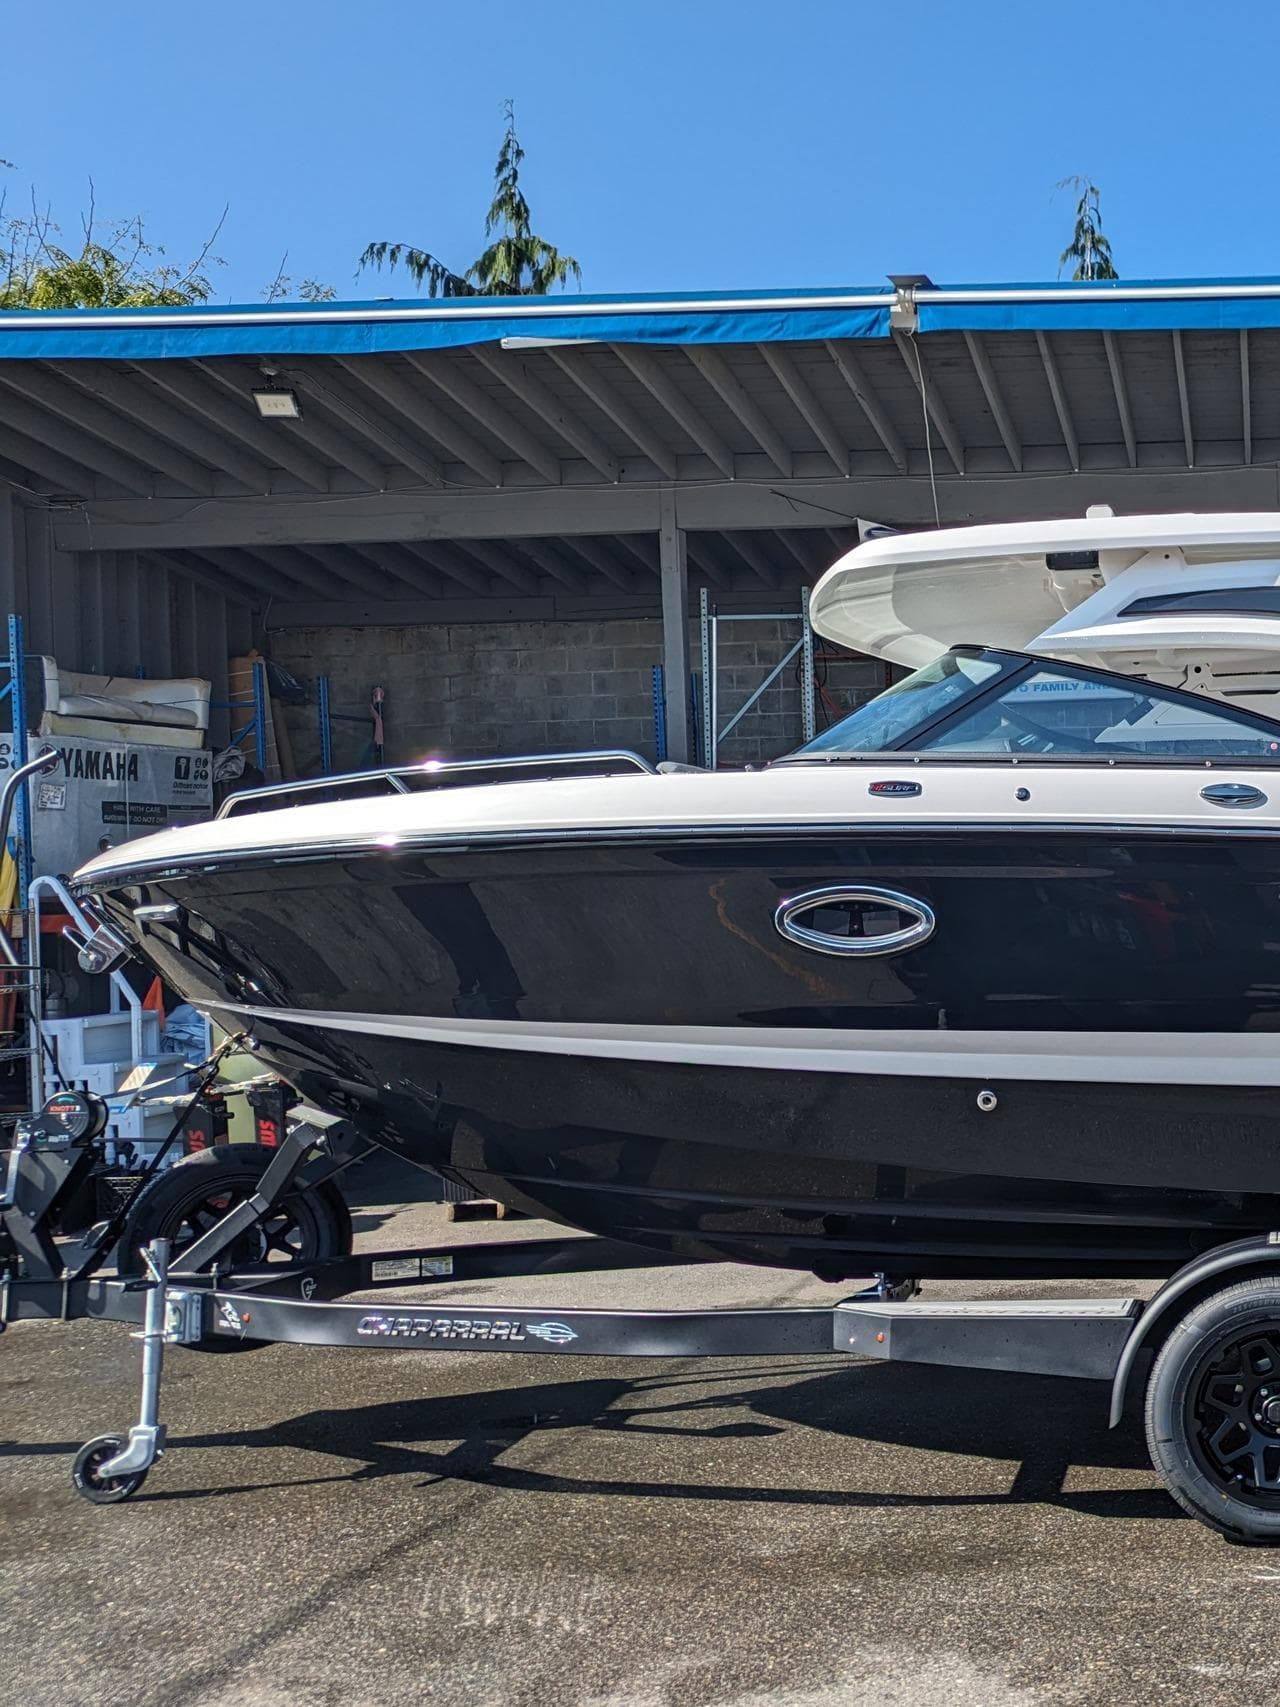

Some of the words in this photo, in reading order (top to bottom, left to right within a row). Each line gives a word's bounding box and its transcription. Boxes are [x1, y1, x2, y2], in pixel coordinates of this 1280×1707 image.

[1033, 682, 1080, 692] FAMILY
[61, 747, 139, 782] YAMAHA
[356, 1315, 527, 1342] CHAPARRAL
